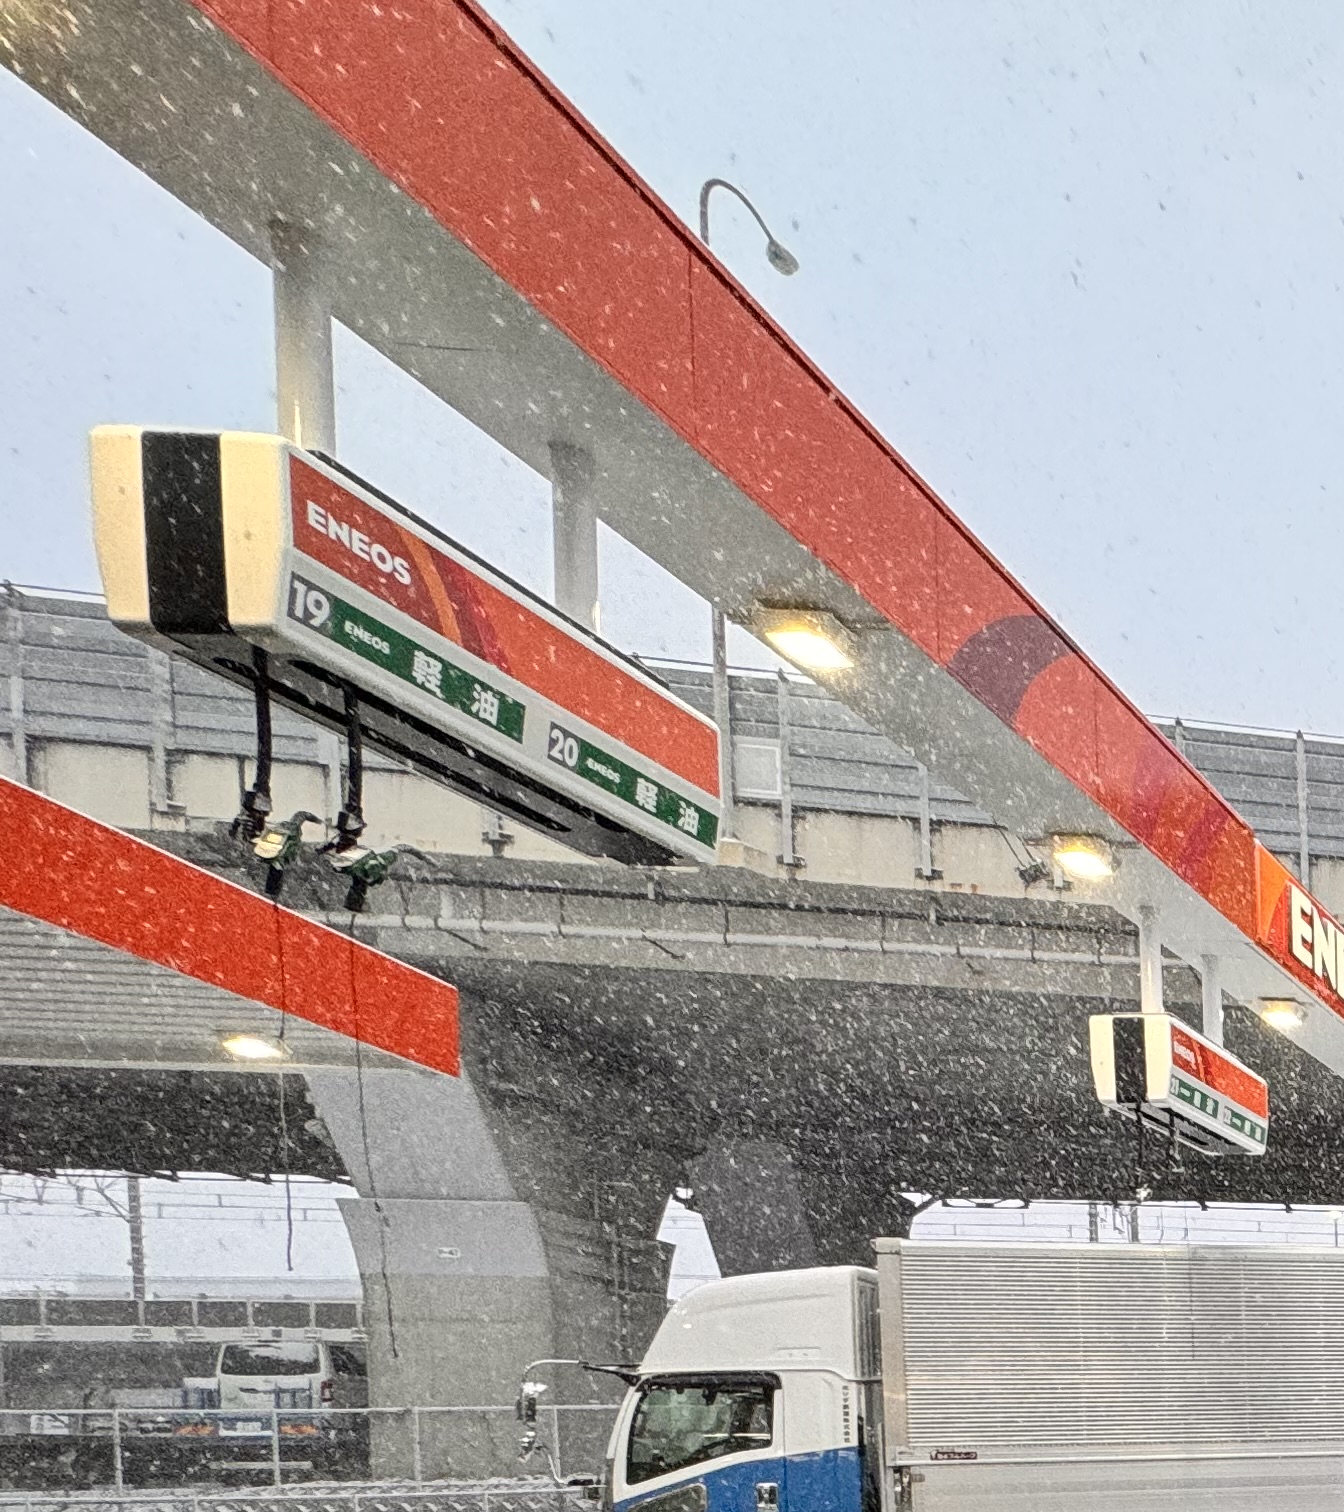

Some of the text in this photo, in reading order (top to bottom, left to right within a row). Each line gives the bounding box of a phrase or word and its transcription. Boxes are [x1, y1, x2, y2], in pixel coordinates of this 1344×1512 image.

[306, 499, 412, 585] ENEOS
[293, 579, 500, 727] 19 ENEOS 軽油
[550, 728, 700, 837] 20 ENEOS 軽油
